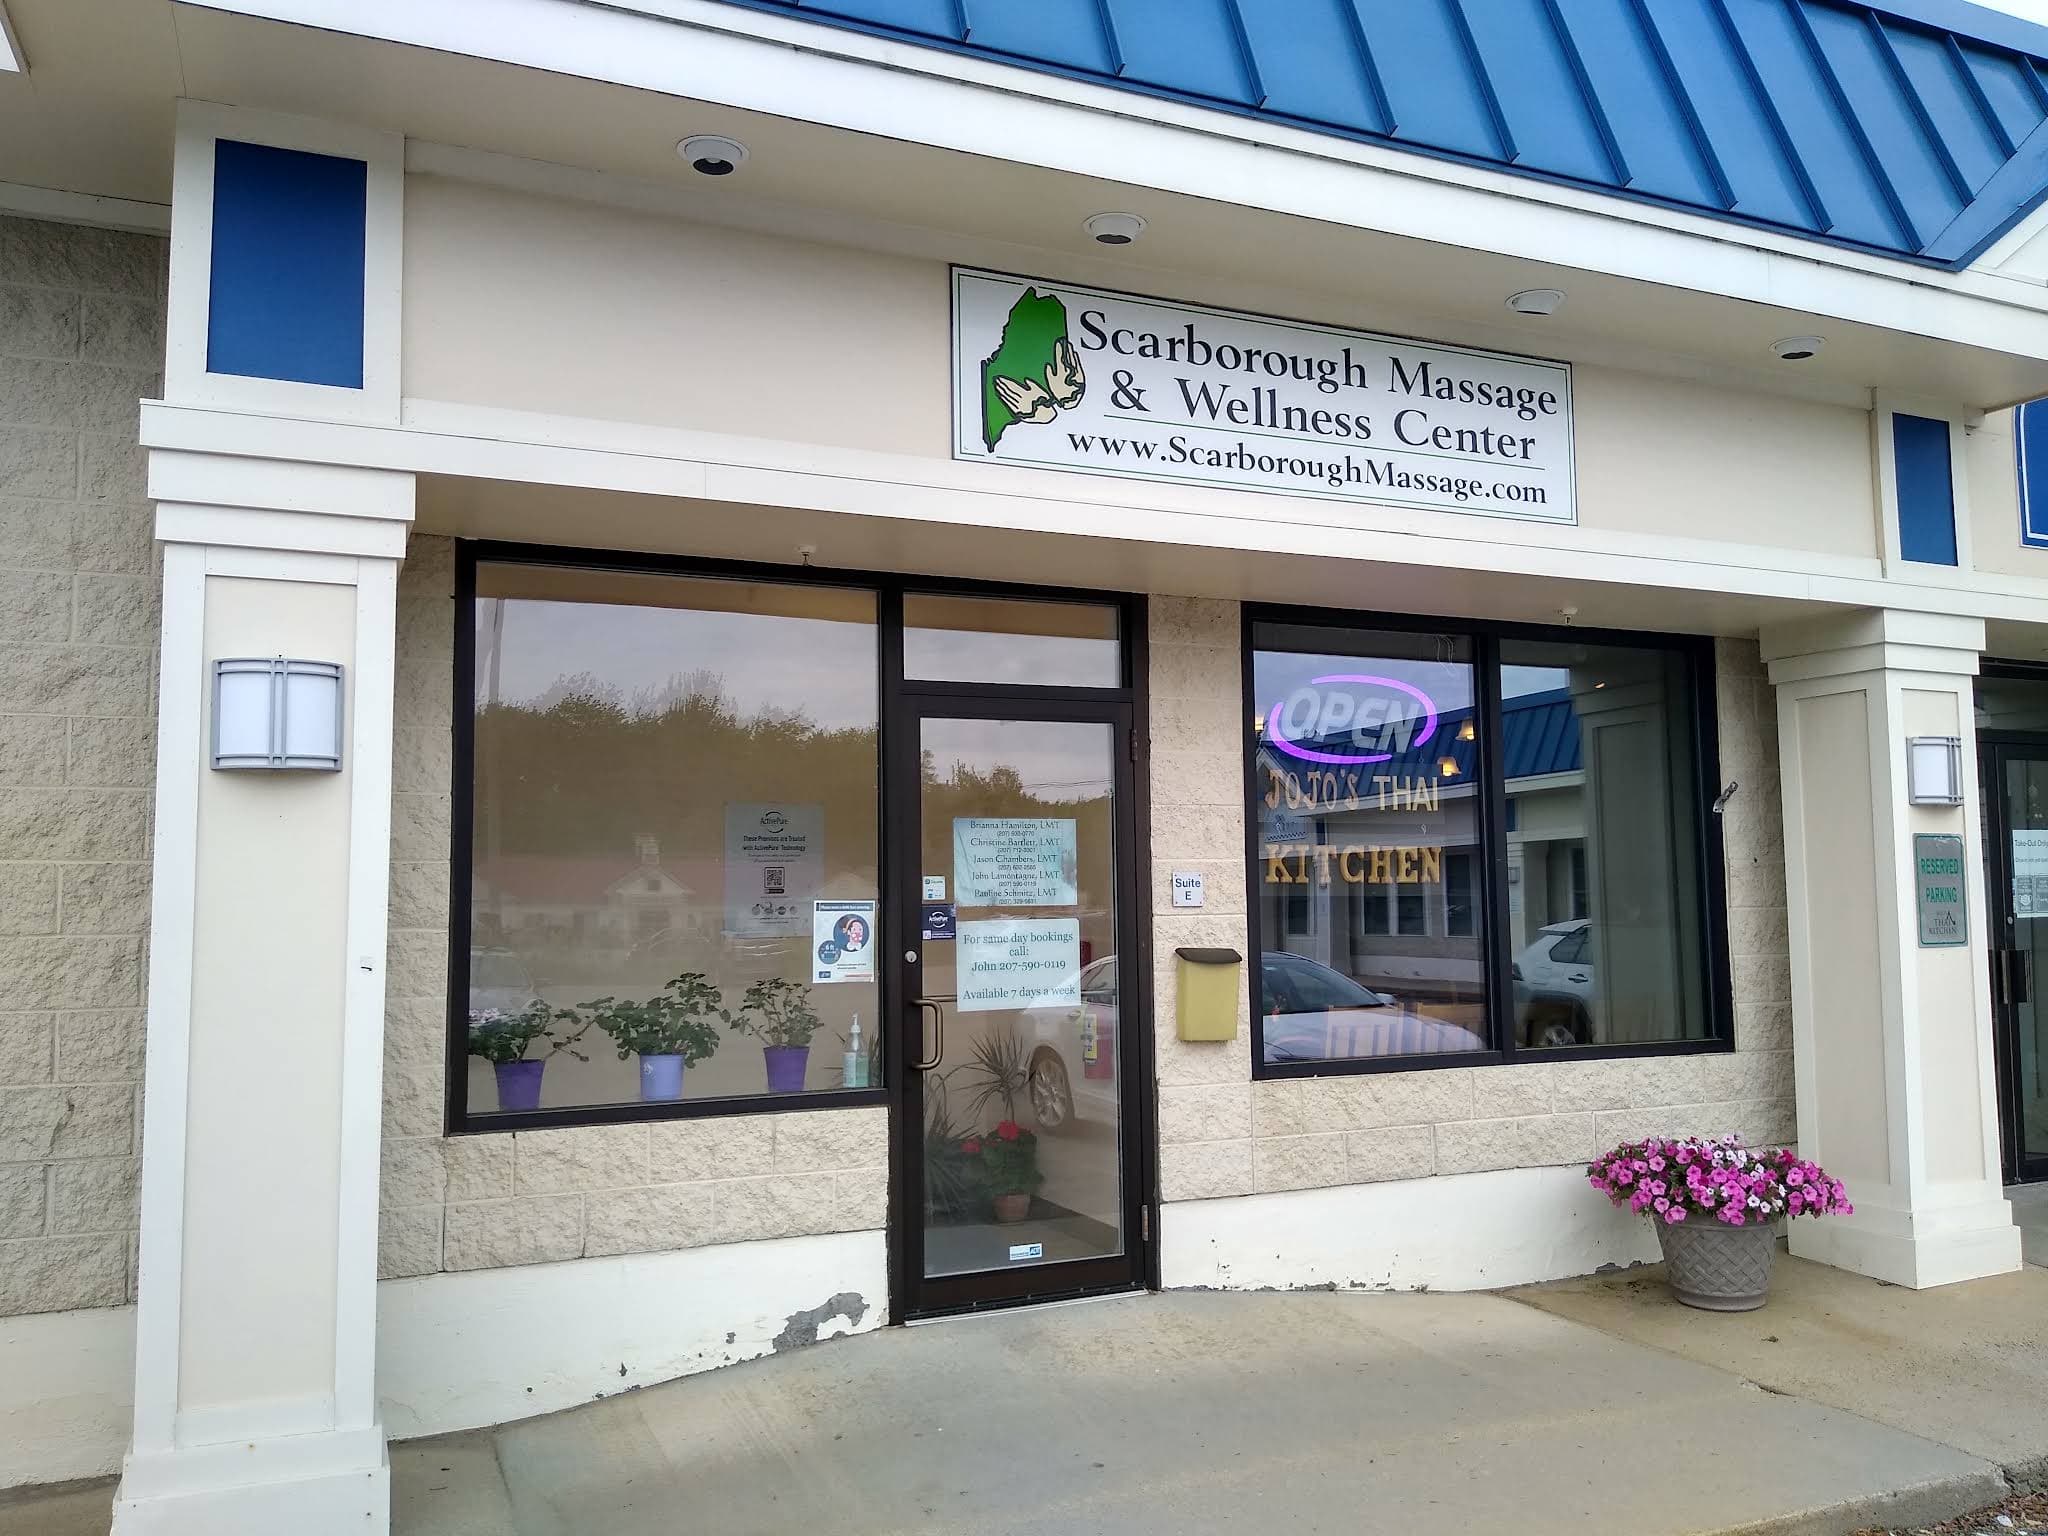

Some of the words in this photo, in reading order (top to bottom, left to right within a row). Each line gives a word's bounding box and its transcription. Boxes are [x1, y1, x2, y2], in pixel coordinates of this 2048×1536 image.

[1079, 310, 1369, 394] Scarborough
[1387, 356, 1558, 421] Massage
[1110, 369, 1152, 412] &
[1173, 376, 1372, 440] Wellness
[1393, 408, 1536, 461] Center
[1067, 432, 1548, 504] www.ScarboroughMassage.com
[1283, 686, 1421, 753] OPEN
[1264, 767, 1359, 811] JOJO'S
[1372, 775, 1440, 812] THAI
[1040, 820, 1060, 829] LMT
[1040, 838, 1060, 847] LMT
[973, 854, 994, 865] Jason
[995, 853, 1036, 864] Chambers,
[1037, 854, 1058, 863] LMT
[1264, 844, 1442, 884] KITCHEN
[1921, 858, 1959, 874] RESERVED
[972, 871, 989, 881] John
[1039, 870, 1060, 880] LMT
[1175, 877, 1201, 888] Suite
[1037, 888, 1058, 898] LMT
[1185, 890, 1192, 901] E
[1925, 887, 1957, 903] PARKING
[963, 934, 982, 945] For
[982, 935, 1009, 944] same
[1011, 932, 1028, 945] day
[1030, 931, 1074, 944] bookings
[1009, 945, 1029, 957] call:
[971, 961, 997, 972] John
[999, 960, 1066, 972] 207-590-0119
[963, 987, 1009, 1000] Available
[1010, 989, 1017, 998] 7
[1019, 986, 1041, 999] days
[1050, 984, 1076, 996] week
